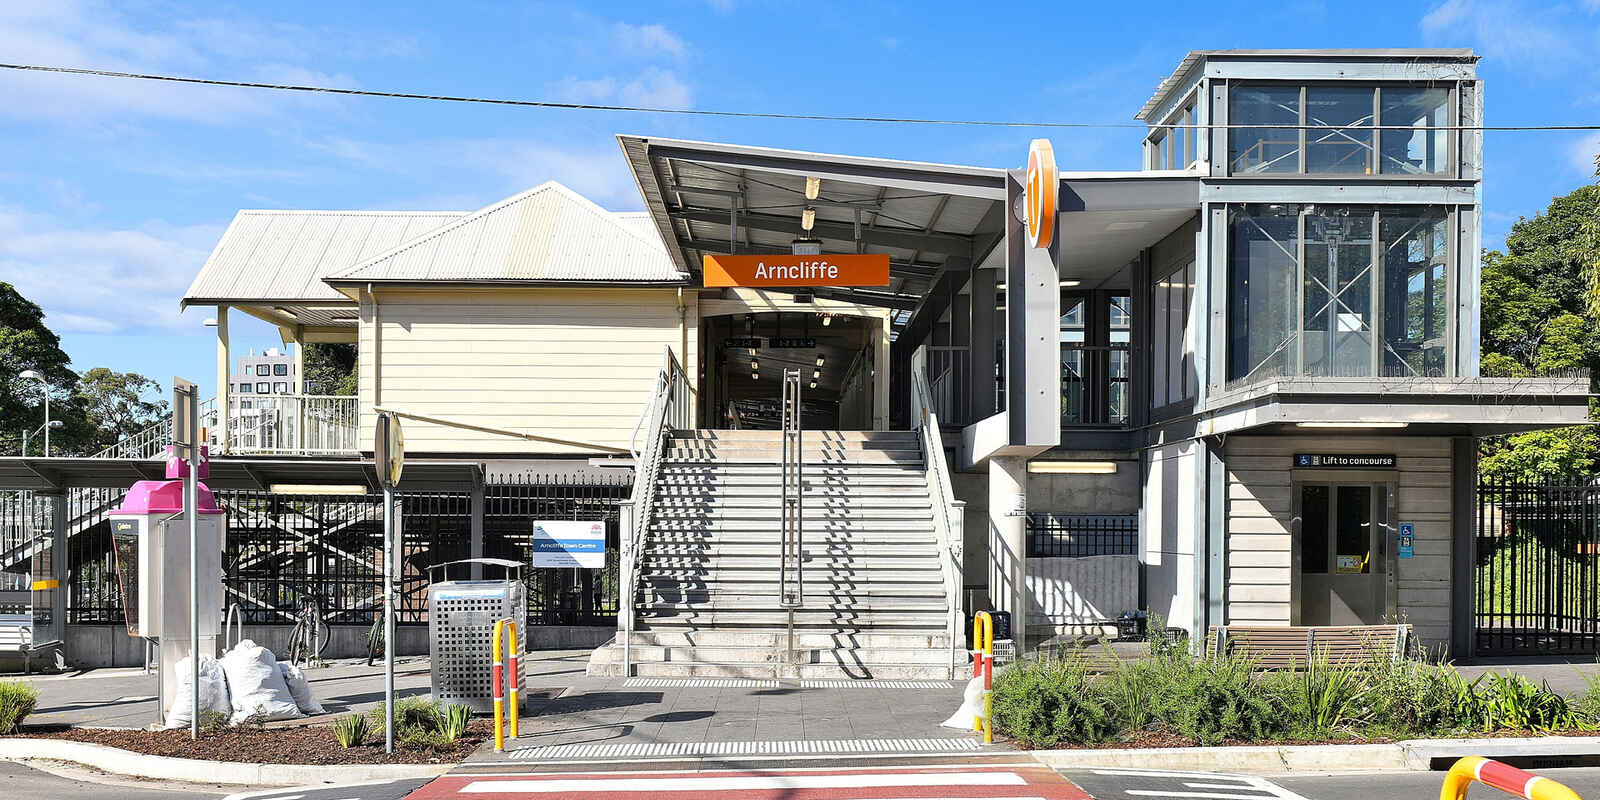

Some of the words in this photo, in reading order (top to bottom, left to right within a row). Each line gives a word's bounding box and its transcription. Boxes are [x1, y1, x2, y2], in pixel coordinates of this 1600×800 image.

[755, 262, 839, 279] Arncliffe
[1323, 457, 1338, 465] Lift
[1339, 457, 1348, 465] to
